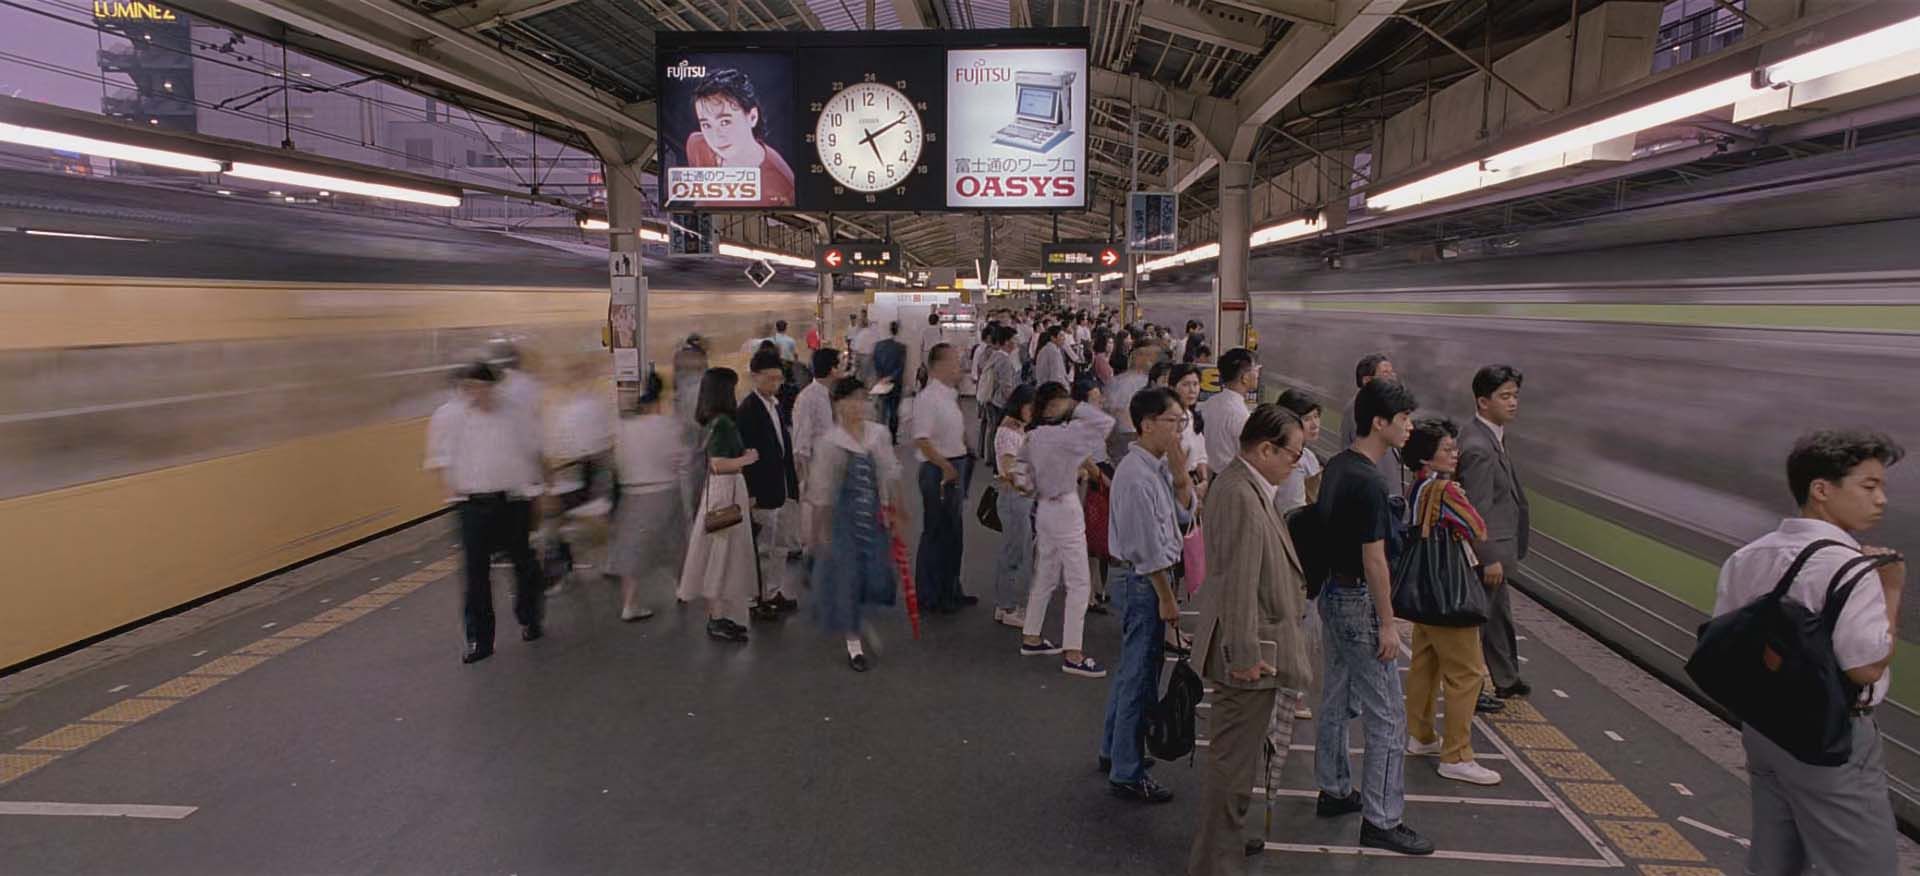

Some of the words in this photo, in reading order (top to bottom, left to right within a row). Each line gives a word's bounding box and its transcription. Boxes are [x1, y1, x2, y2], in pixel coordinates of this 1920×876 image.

[667, 60, 706, 80] FUJITSU
[956, 59, 1011, 85] FUJITSU
[845, 98, 854, 112] 11
[863, 92, 874, 106] 12
[886, 96, 890, 111] 1
[831, 113, 842, 127] 10
[898, 111, 906, 124] 2
[828, 134, 836, 147] 9
[904, 130, 912, 143] 3
[834, 153, 842, 166] 8
[899, 150, 907, 162] 4
[848, 166, 856, 179] 7
[886, 164, 894, 177] 5
[955, 158, 1075, 173] 富士通のワープロ
[868, 171, 875, 184] 6
[672, 182, 756, 198] OASYS
[956, 176, 1076, 197] OASYS
